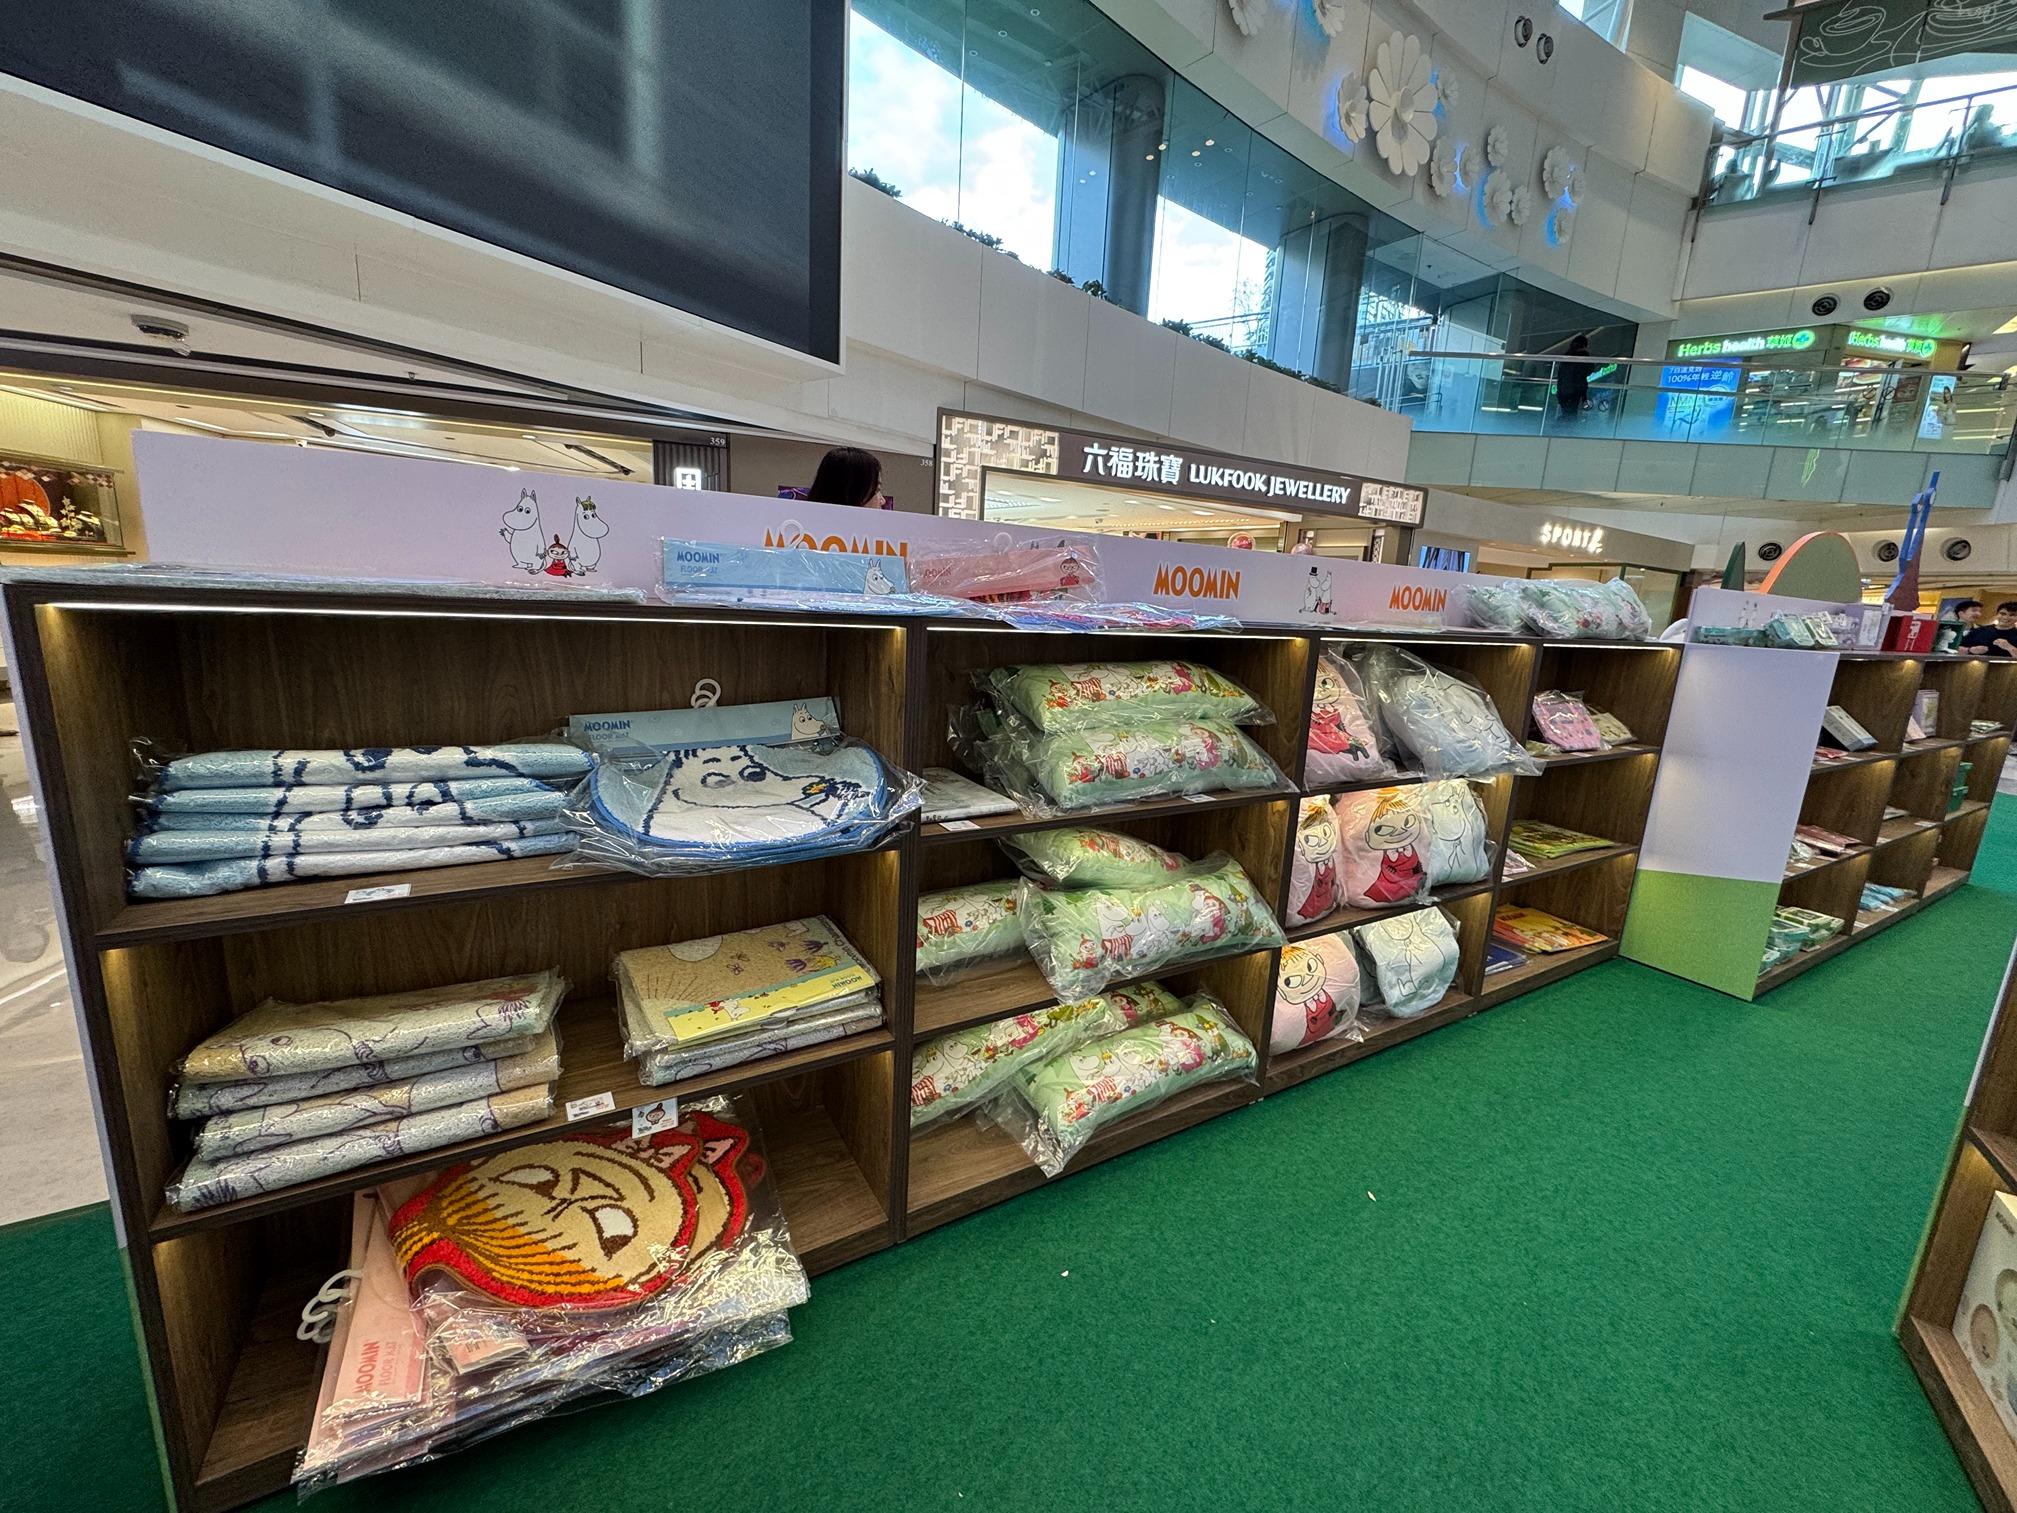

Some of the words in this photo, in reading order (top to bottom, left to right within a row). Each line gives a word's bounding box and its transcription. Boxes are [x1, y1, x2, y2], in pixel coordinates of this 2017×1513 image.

[1677, 341, 1722, 357] Herbs
[1722, 336, 1766, 353] health
[709, 437, 726, 447] 359
[919, 458, 934, 468] 358
[1083, 442, 1184, 486] 六福珠寶
[1189, 464, 1268, 493] LUKFOOK
[1267, 477, 1351, 505] JEWELLERY
[676, 551, 720, 564] MOOMIN
[1152, 563, 1241, 600] MOOMIN
[1388, 584, 1448, 613] MOOMIN
[583, 720, 632, 732] MOOMIN
[352, 1340, 380, 1393] MOOMIN
